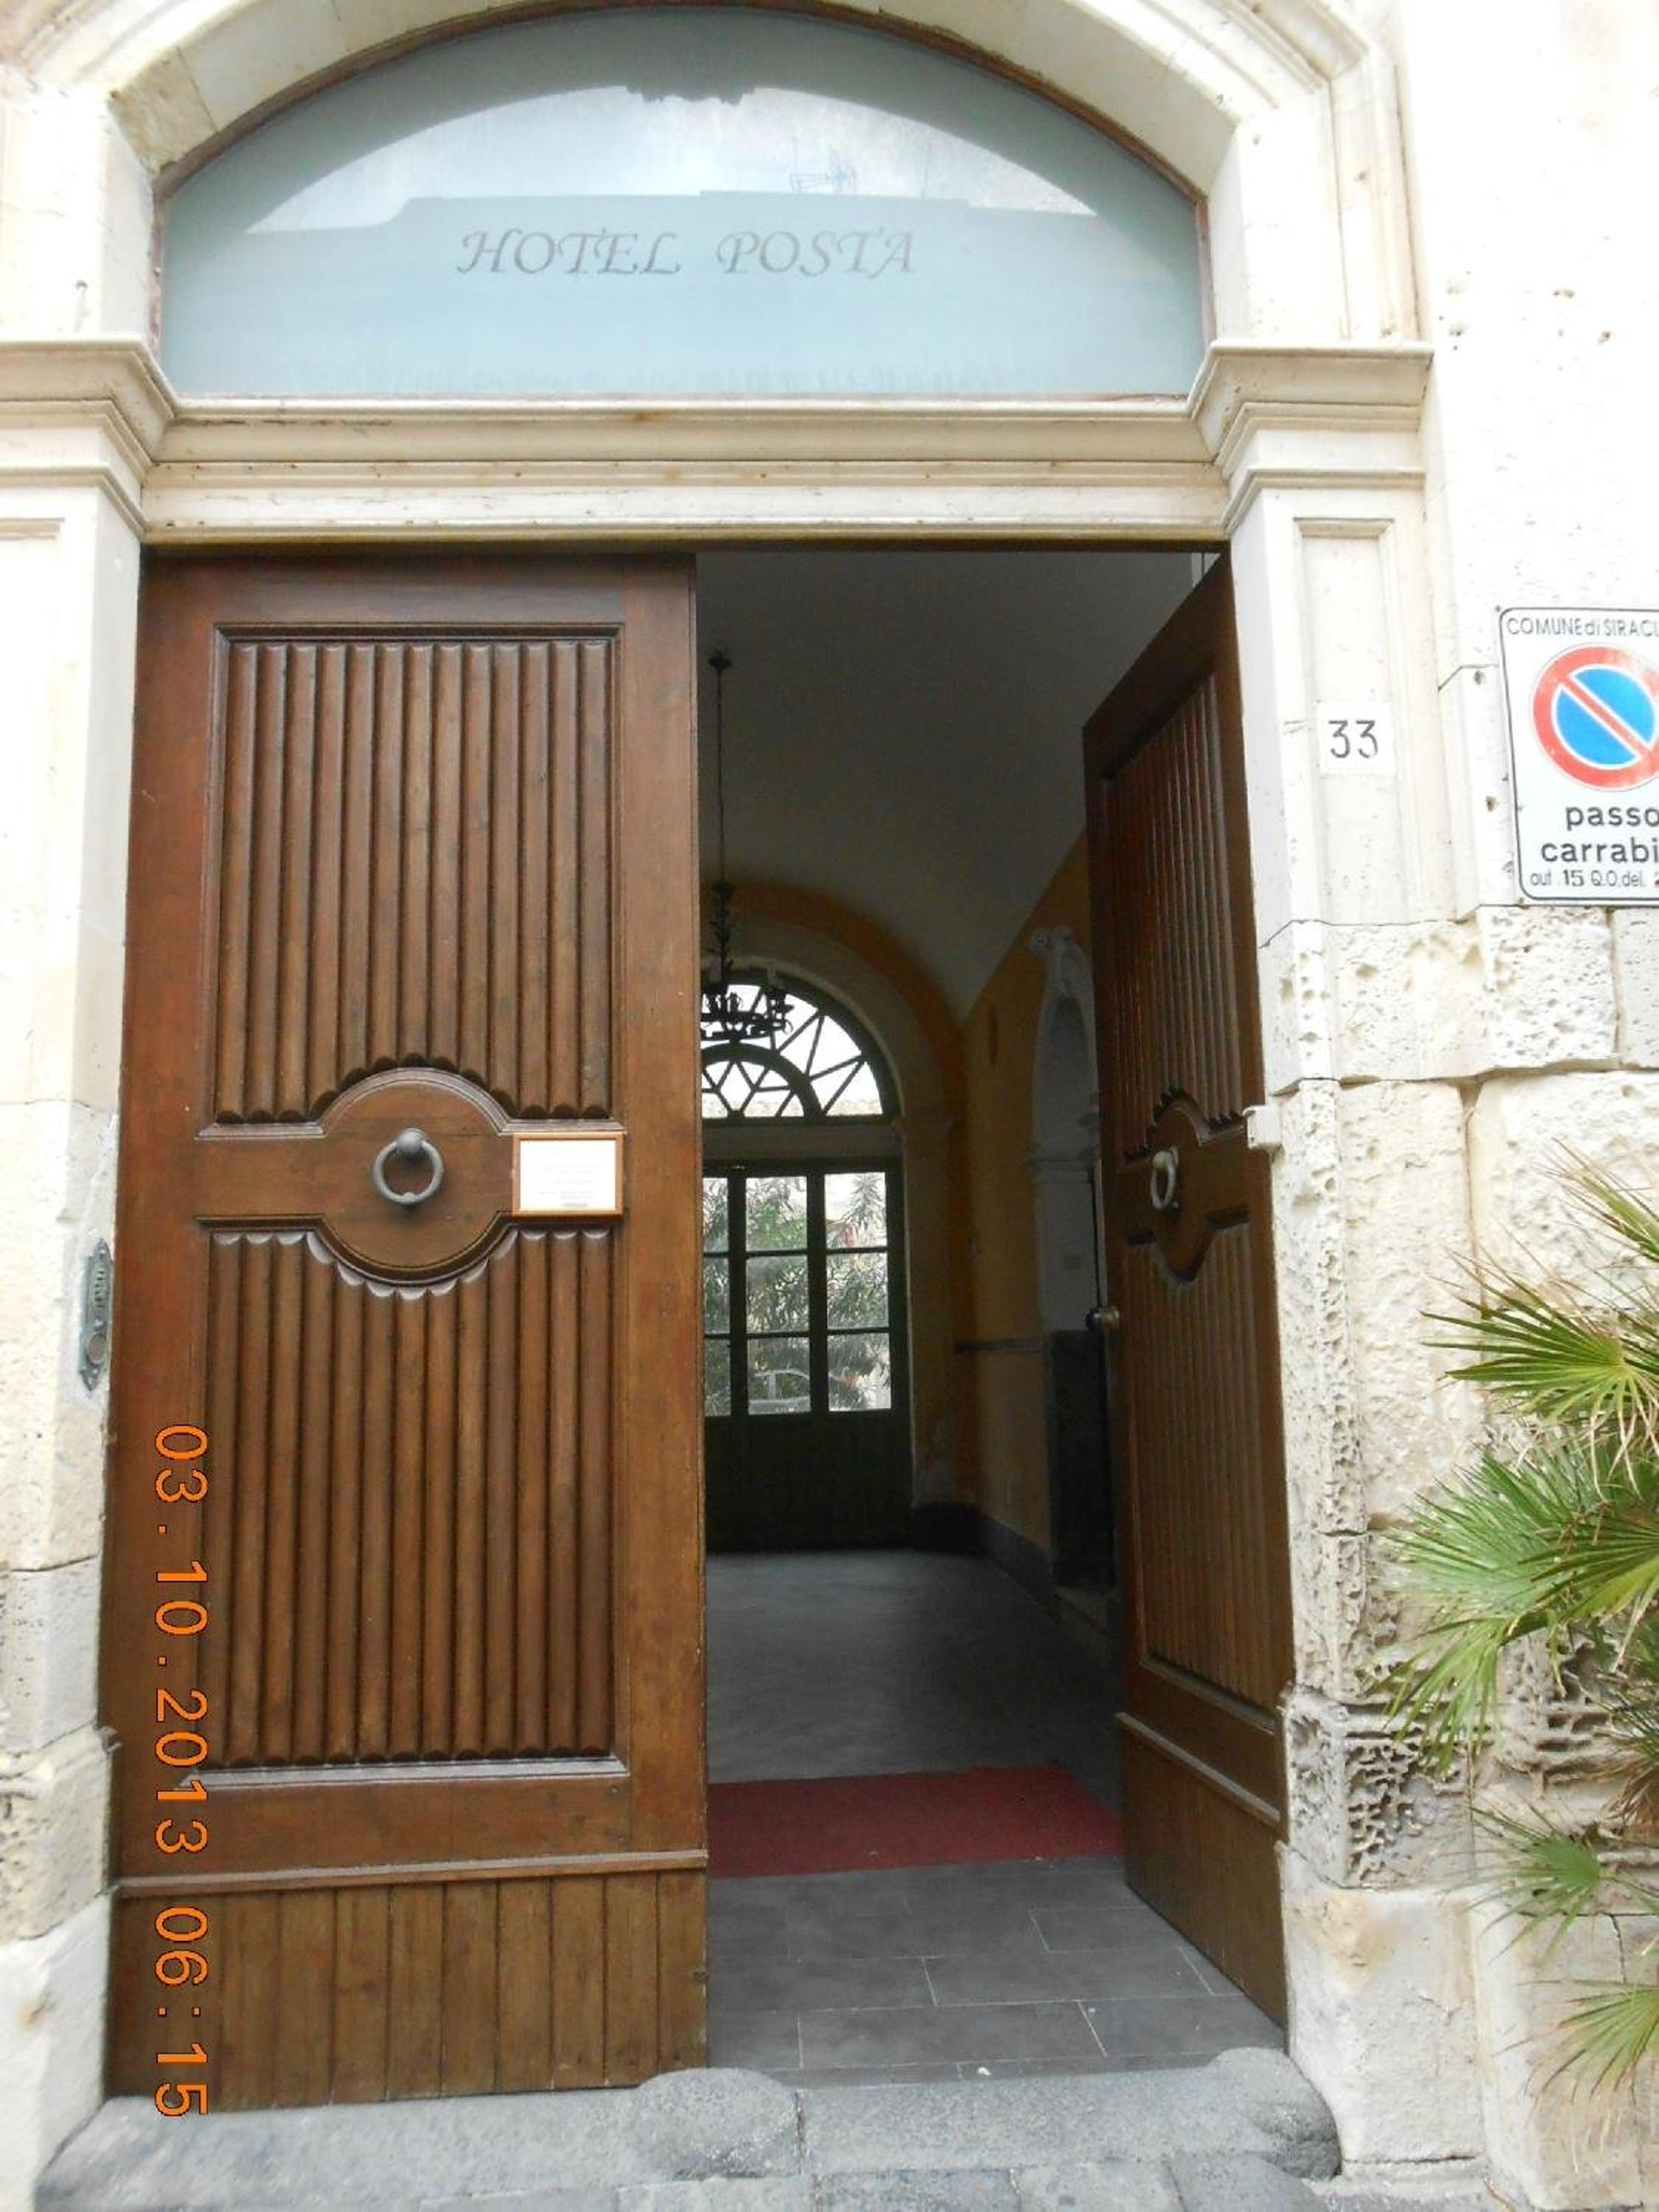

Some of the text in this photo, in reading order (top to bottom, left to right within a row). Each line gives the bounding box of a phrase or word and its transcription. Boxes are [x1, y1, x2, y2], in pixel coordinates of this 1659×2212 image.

[458, 228, 914, 278] HOTEL POSTA
[1507, 617, 1582, 635] COMUNE
[1585, 618, 1600, 636] di
[1328, 720, 1378, 758] 33
[1566, 807, 1659, 830] passo
[1541, 837, 1659, 862] carrabi
[1563, 870, 1584, 886] 15
